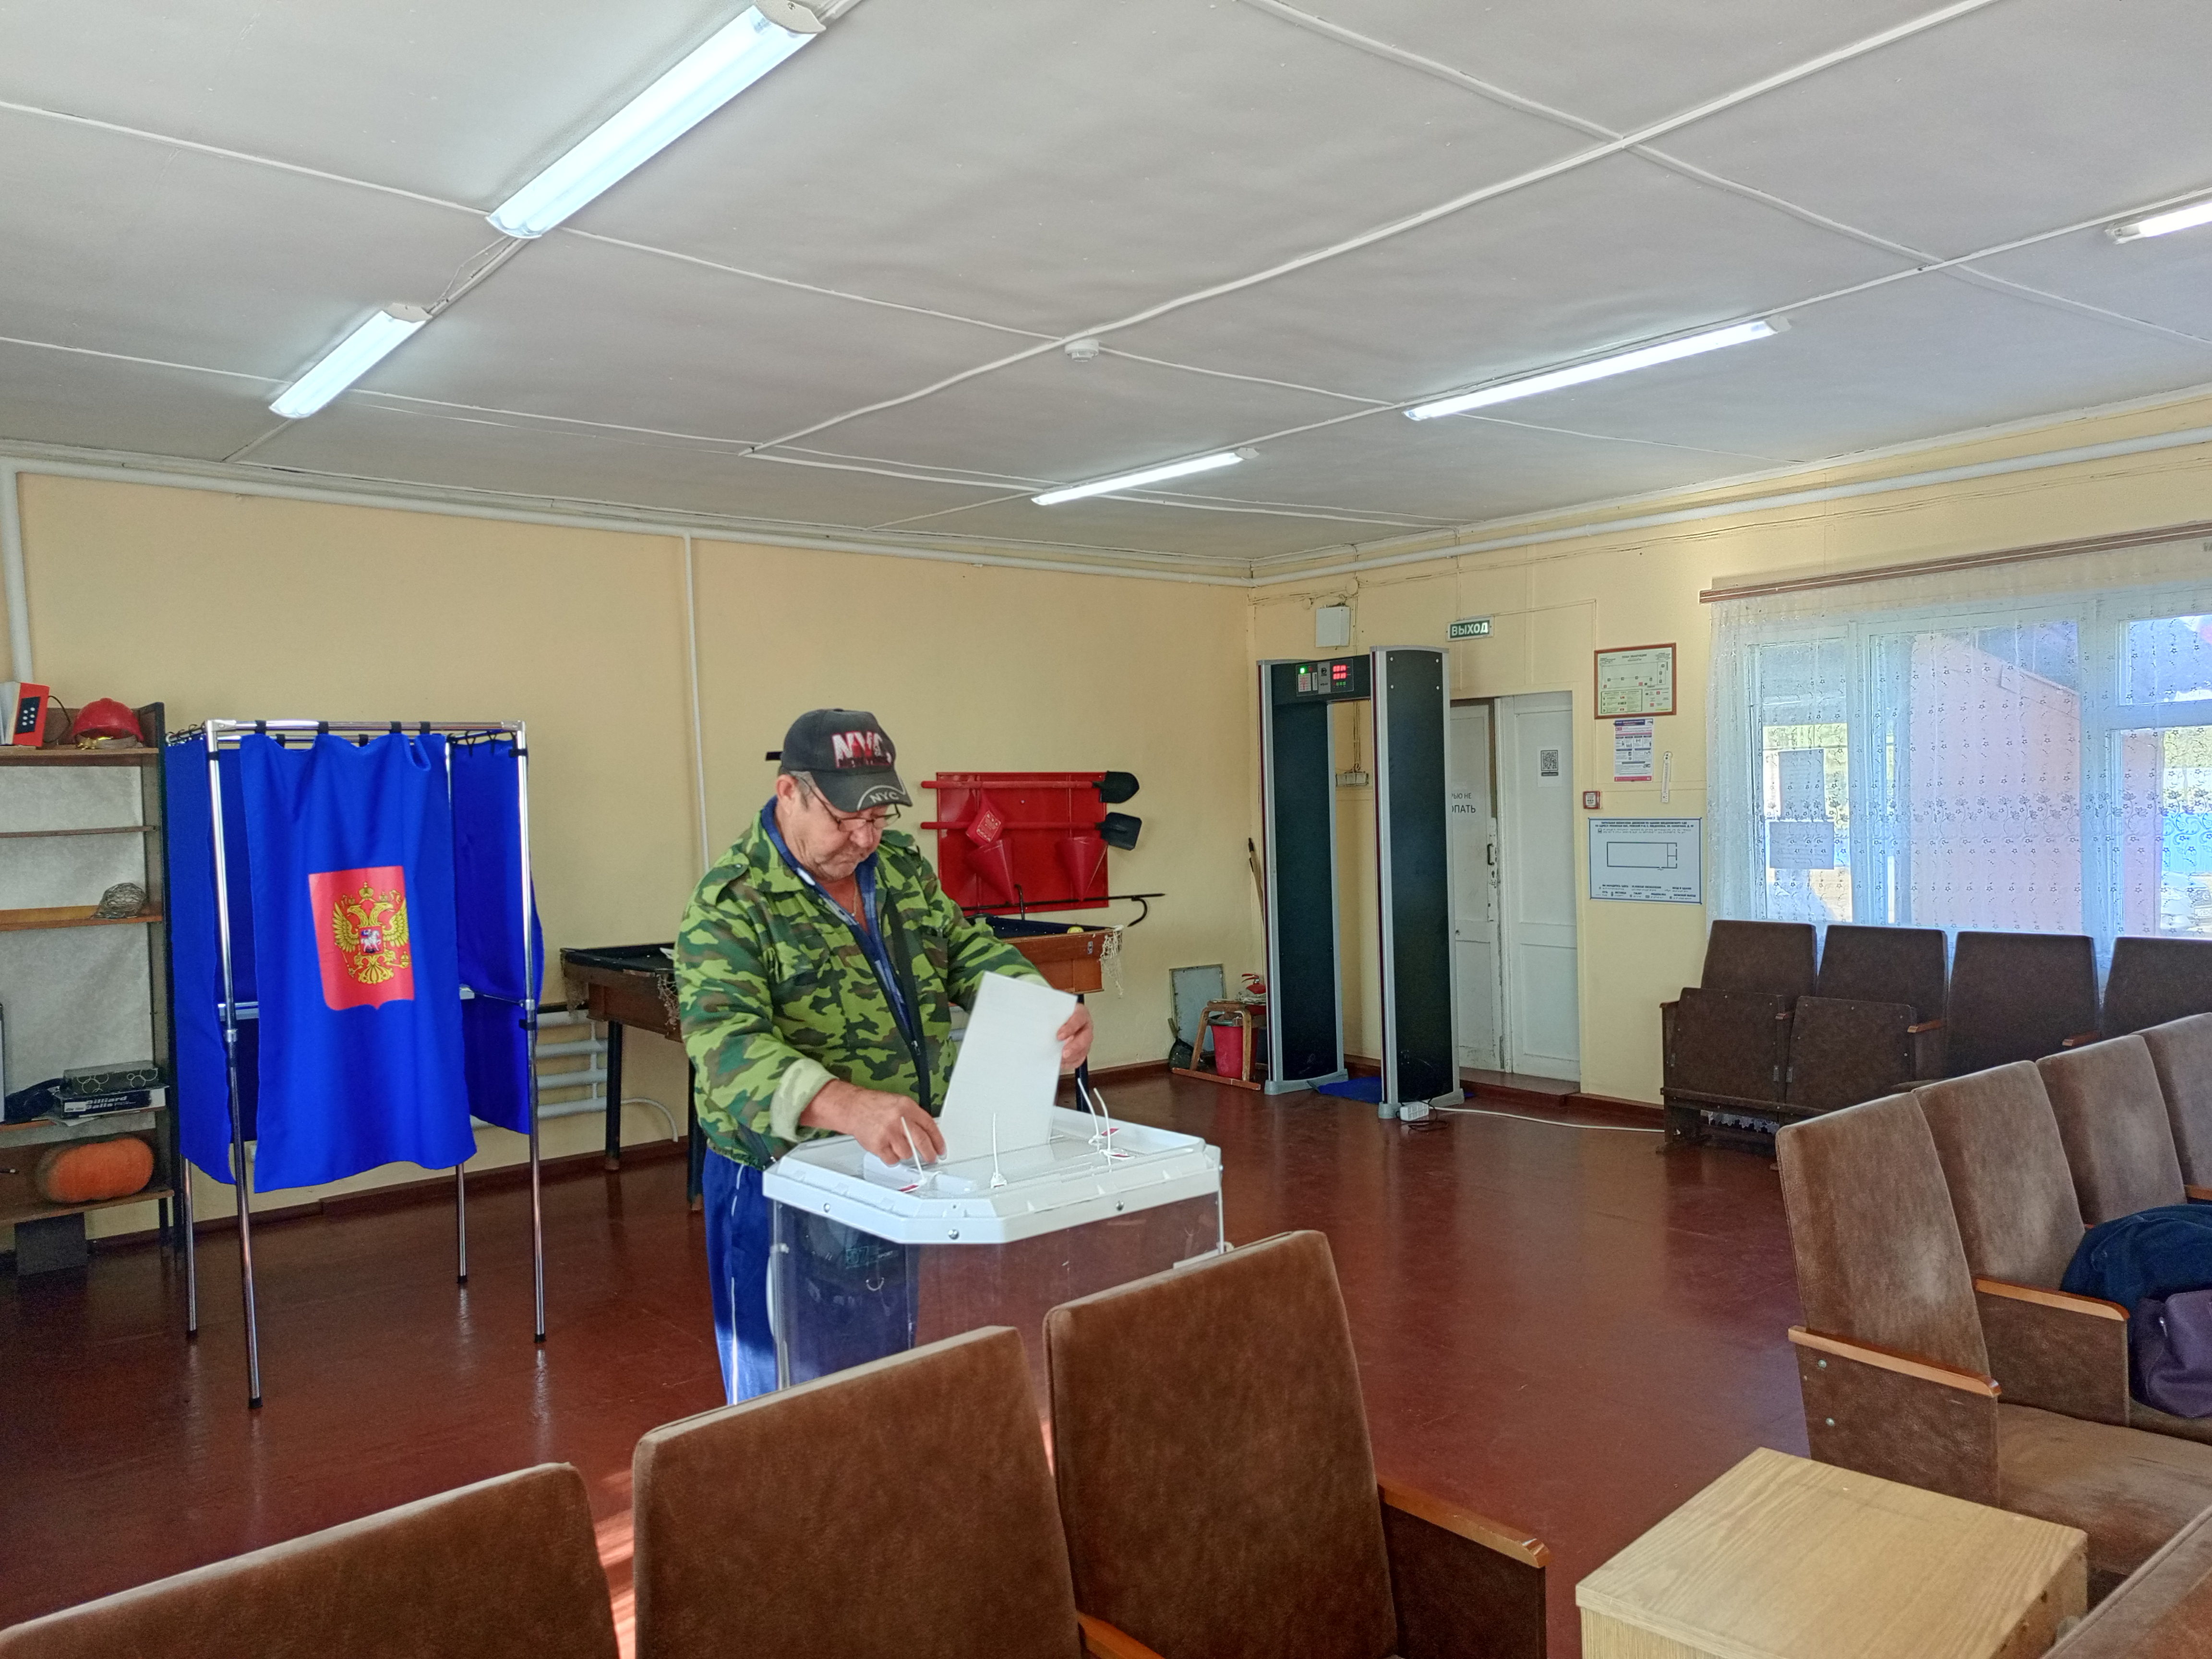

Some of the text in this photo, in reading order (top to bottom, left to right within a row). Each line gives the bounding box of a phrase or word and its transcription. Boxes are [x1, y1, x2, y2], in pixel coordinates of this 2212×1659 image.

[1452, 622, 1488, 636] ВЫХОД
[831, 731, 892, 769] NYC
[869, 792, 900, 803] NYC
